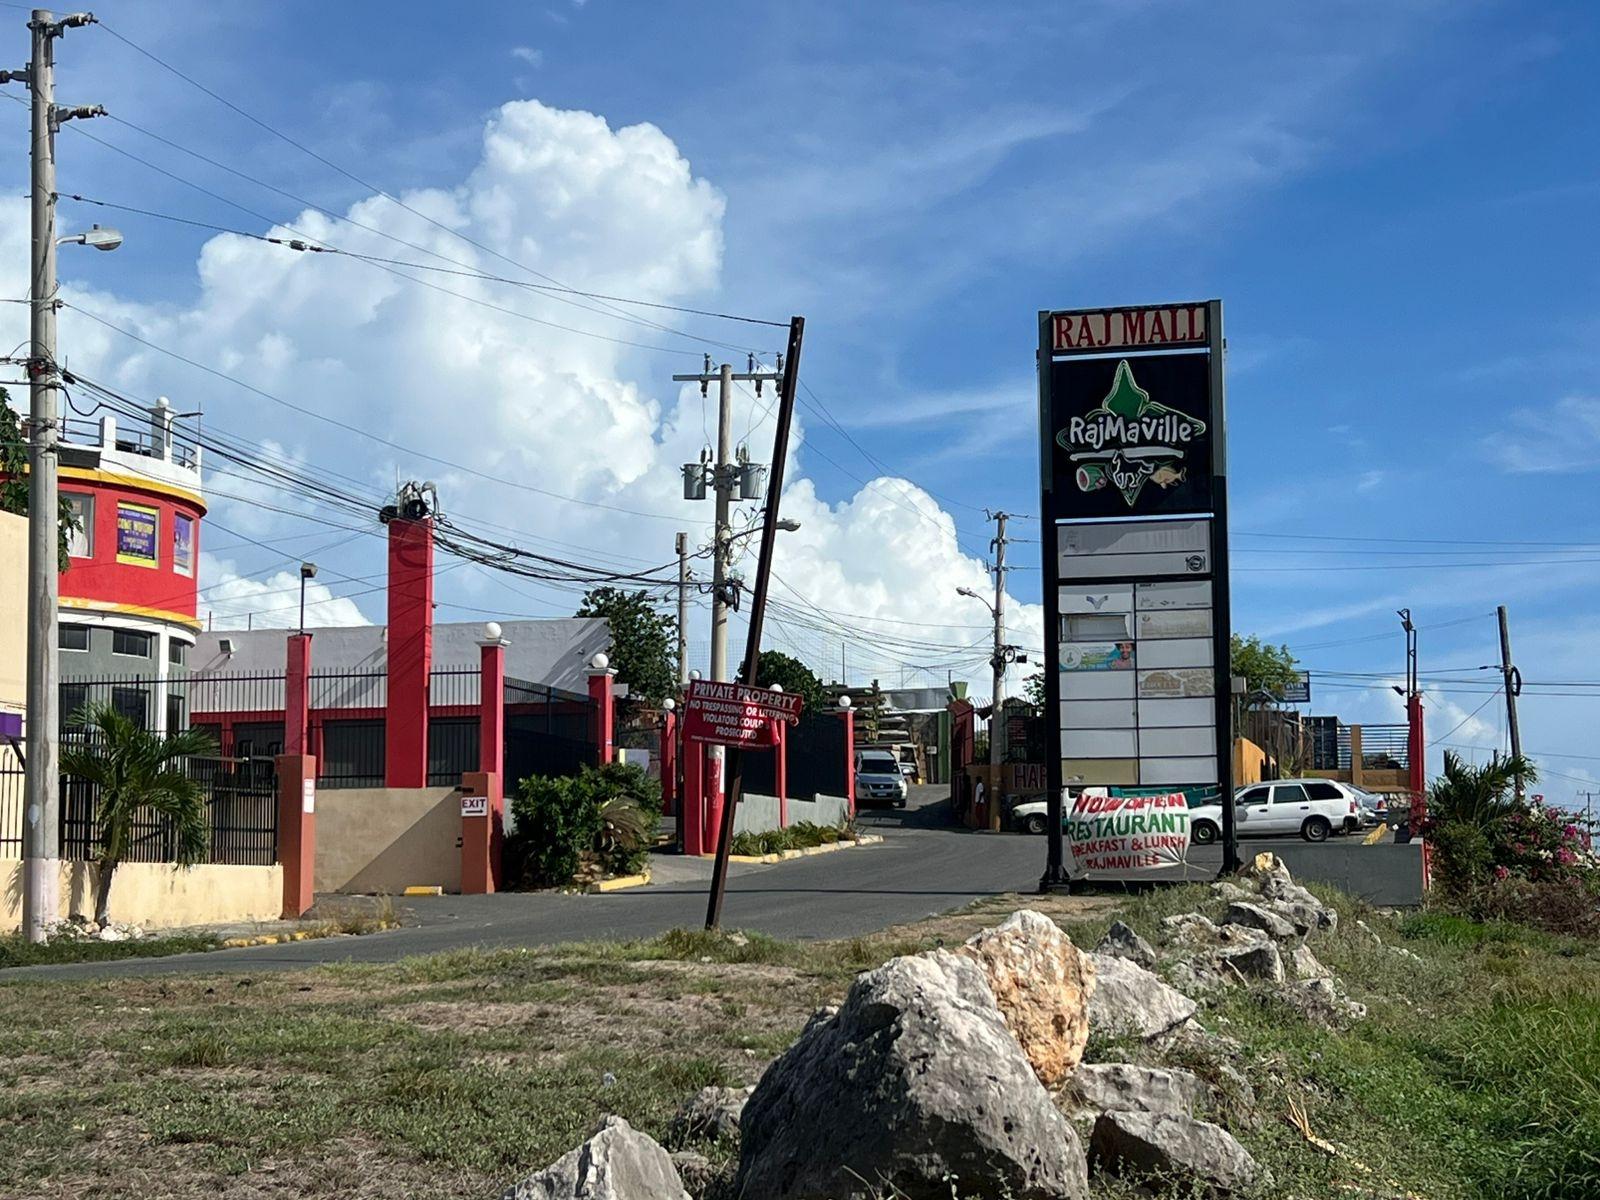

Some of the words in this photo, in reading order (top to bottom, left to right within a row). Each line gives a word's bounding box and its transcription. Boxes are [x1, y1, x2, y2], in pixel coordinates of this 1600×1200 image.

[1055, 312, 1112, 348] RAJ
[1122, 307, 1204, 344] MALL
[693, 683, 734, 699] PRIVATE
[736, 688, 797, 710] PROPERTY
[689, 700, 701, 710] NO
[701, 701, 744, 715] TRESPASSING
[745, 706, 757, 717] OR
[702, 712, 739, 726] VIOLATORS
[462, 799, 485, 807] EXIT
[1073, 794, 1120, 813] NOW
[1124, 792, 1185, 811] OPEN
[1068, 813, 1189, 841] RESTAURANT
[1131, 839, 1143, 851] &
[1144, 836, 1186, 851] LUNCH
[1086, 852, 1161, 870] RAJMAVILLE
